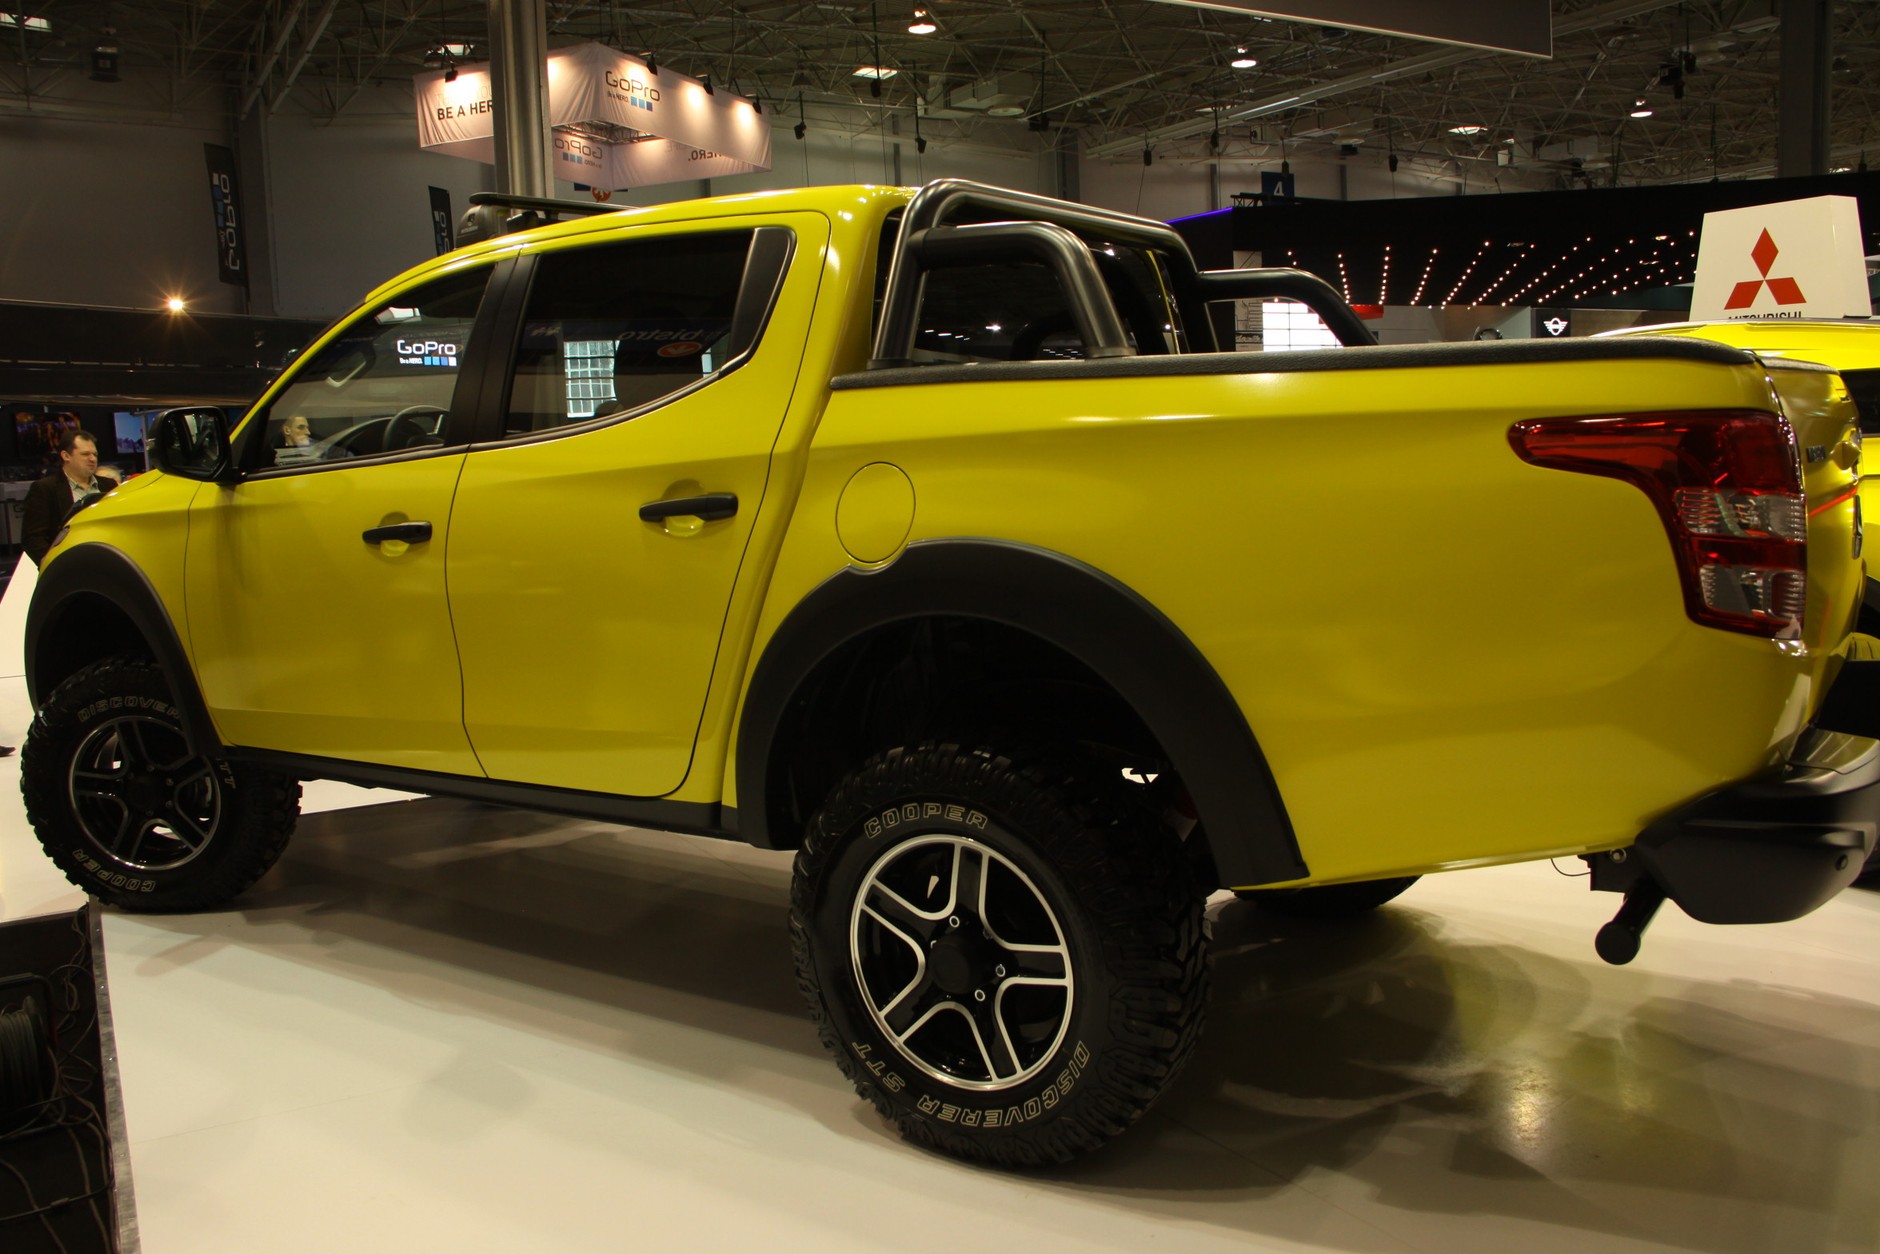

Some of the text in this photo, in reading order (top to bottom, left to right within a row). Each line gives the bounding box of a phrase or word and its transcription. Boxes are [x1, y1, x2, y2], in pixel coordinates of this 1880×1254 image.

[606, 70, 660, 102] GoPro
[437, 99, 493, 121] BE A HER
[1273, 180, 1285, 197] 4
[397, 339, 456, 356] GoPro
[77, 695, 181, 723] DISCOVER
[863, 802, 989, 839] COOPER
[72, 849, 156, 892] COOPER
[851, 1040, 1091, 1129] DISCOVERER STT
